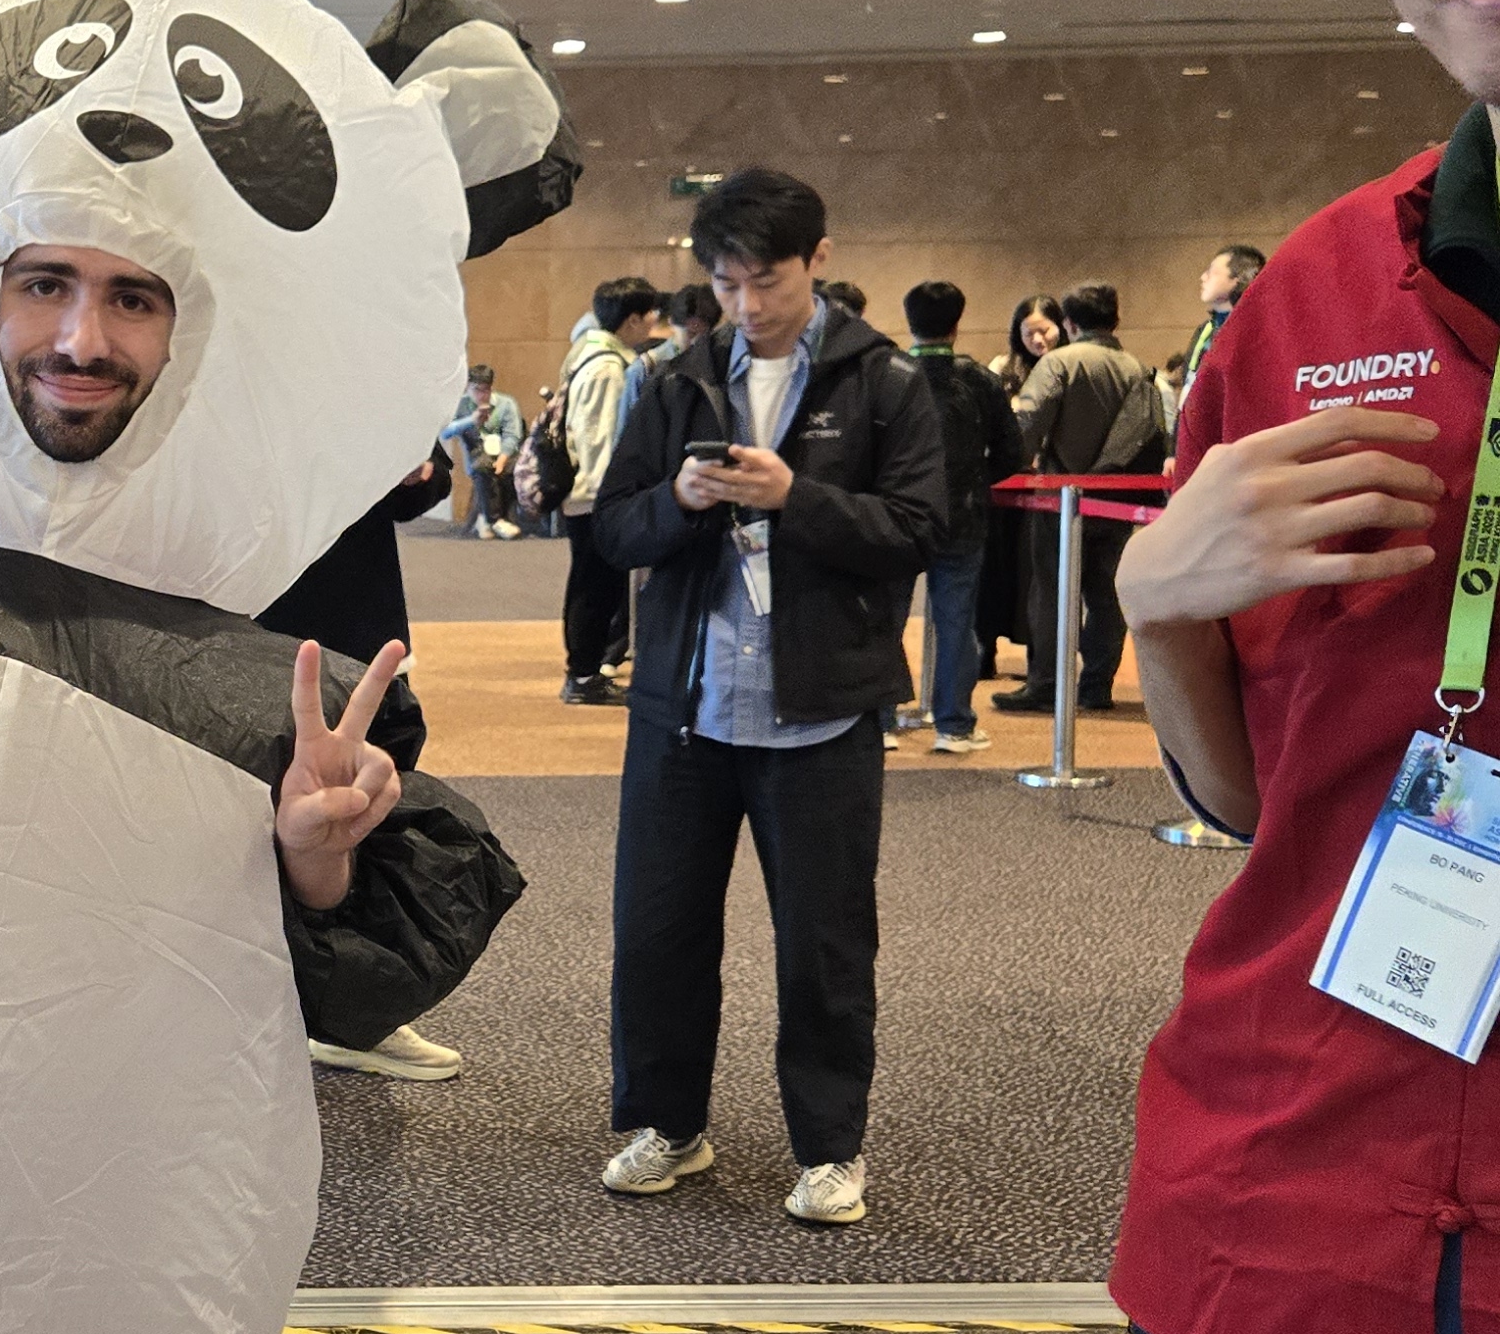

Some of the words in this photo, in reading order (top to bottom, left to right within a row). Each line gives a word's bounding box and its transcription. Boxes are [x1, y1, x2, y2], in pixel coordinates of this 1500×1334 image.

[1309, 395, 1354, 411] Lenovo
[1363, 386, 1403, 403] AMD
[1465, 508, 1483, 562] SIGGRAPH
[1476, 536, 1490, 563] ASIA
[1429, 853, 1448, 868] BO
[1449, 861, 1485, 883] PANG
[1357, 983, 1385, 1006] FULL
[1388, 999, 1438, 1029] ACCESS
